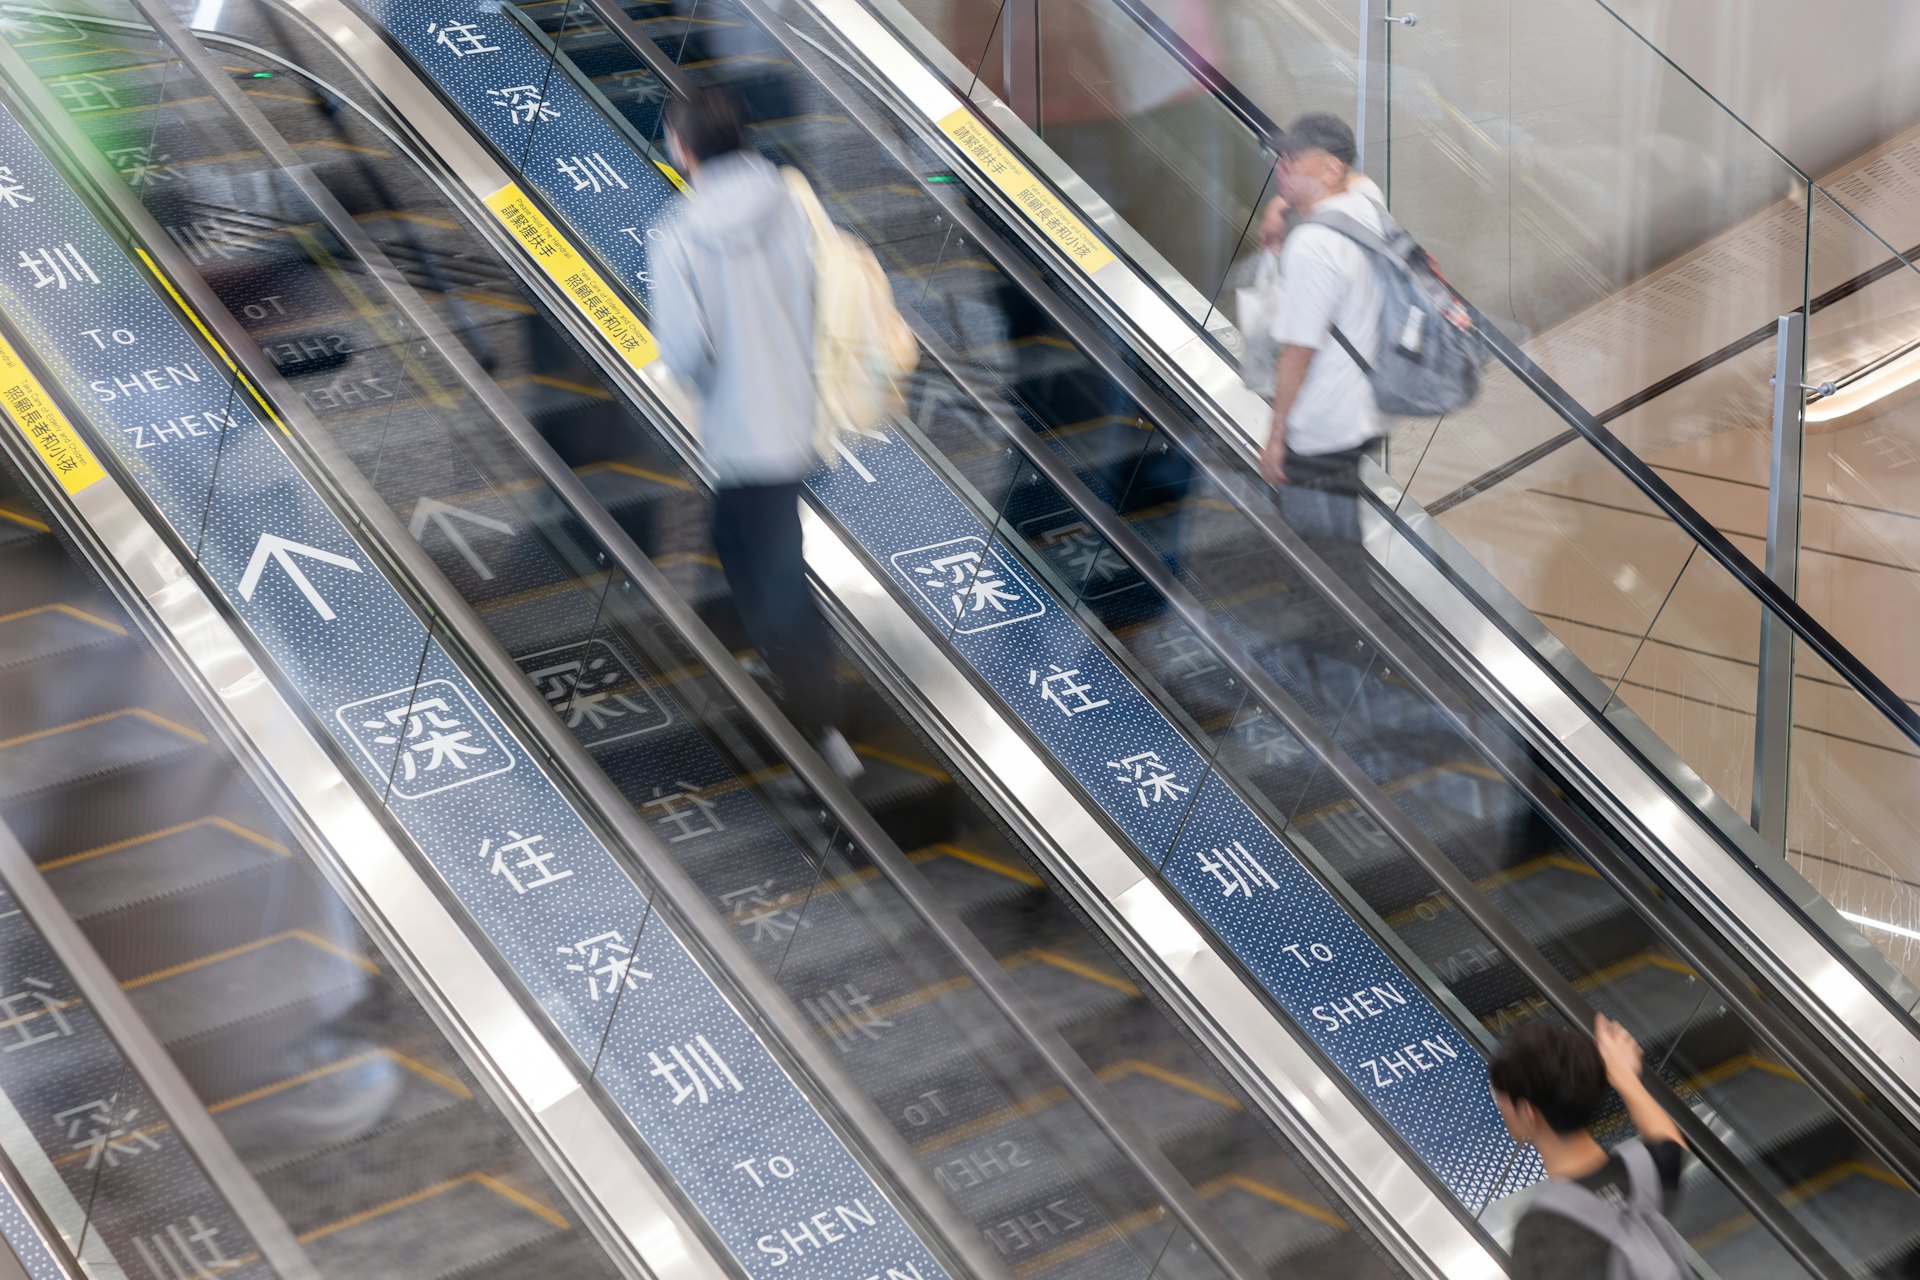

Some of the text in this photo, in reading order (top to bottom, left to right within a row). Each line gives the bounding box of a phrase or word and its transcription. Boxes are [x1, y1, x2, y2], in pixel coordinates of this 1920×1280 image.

[953, 125, 1008, 174] 請緊握扶手
[966, 121, 982, 136] Please
[980, 136, 993, 149] Hold
[1002, 156, 1022, 176] Handrail
[501, 203, 557, 257] 請緊握扶手
[517, 198, 574, 259] Please Hold The Handrail
[1017, 188, 1091, 258] 照顧長者和小孩
[1029, 184, 1040, 195] Take
[1040, 194, 1052, 206] Care
[1056, 209, 1071, 225] Elderly
[1079, 232, 1099, 252] Children
[564, 273, 640, 352] 照顧長者和小孩
[580, 268, 591, 281] Take
[590, 280, 601, 293] Care
[606, 297, 621, 315] Elderly
[620, 314, 630, 325] and
[629, 323, 648, 345] Children
[89, 362, 201, 403] SHEN
[3, 385, 78, 474] 照顧長者和小孩
[20, 379, 32, 394] Take
[31, 393, 42, 407] Care
[46, 412, 61, 432] Elderly
[60, 432, 70, 443] and
[68, 442, 87, 466] Children
[122, 407, 239, 450] ZHEN
[914, 551, 1021, 620] 深
[362, 697, 487, 780] 深
[1311, 981, 1408, 1033] SHEN
[1359, 1034, 1458, 1089] ZHEN
[756, 1198, 876, 1268] SHEN
